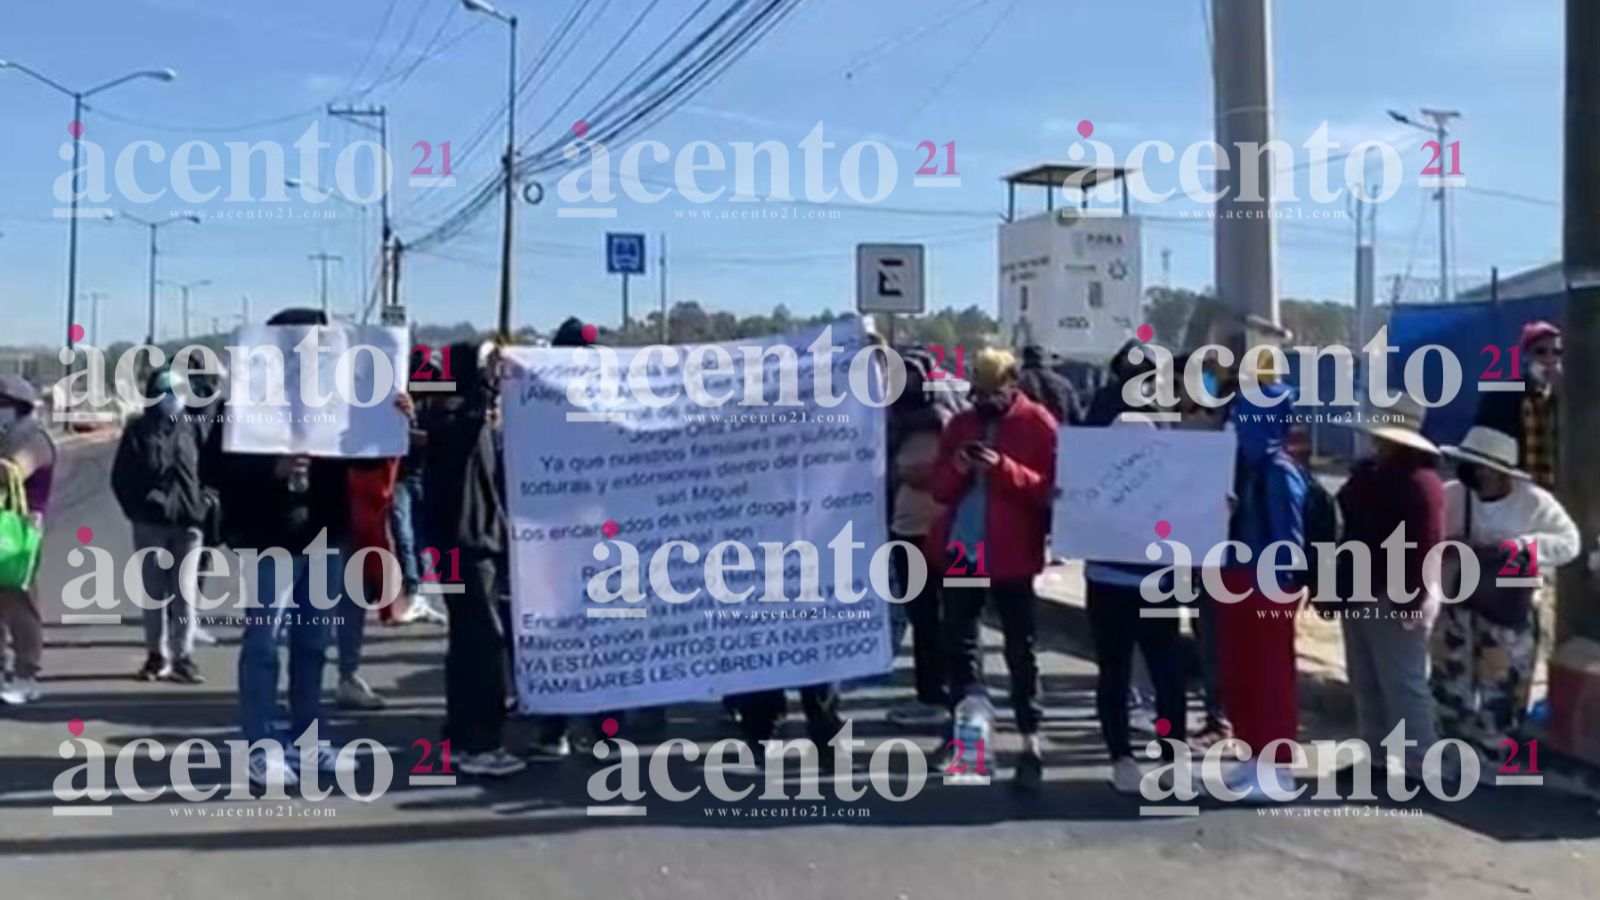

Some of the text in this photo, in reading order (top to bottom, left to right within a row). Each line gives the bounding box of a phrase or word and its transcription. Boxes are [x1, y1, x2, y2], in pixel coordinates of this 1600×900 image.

[520, 479, 592, 496] torturas
[596, 480, 608, 496] y
[716, 457, 770, 478] dentro
[773, 453, 799, 470] del
[540, 456, 565, 472] Ya
[569, 456, 605, 474] que
[608, 449, 686, 468] nuestros
[692, 480, 749, 503] Miguel
[511, 524, 544, 541] Los
[550, 516, 654, 540] encardos
[658, 515, 680, 533] de
[747, 500, 796, 518] droga
[519, 634, 585, 652] Marcos
[551, 648, 646, 674] ESTAMOS
[650, 636, 716, 661] ARTOS
[720, 631, 762, 651] QUE
[782, 616, 883, 645] NUESTROS
[527, 668, 645, 694] FAMILIARES
[650, 661, 687, 683] LES
[690, 652, 773, 677] COBREN
[777, 647, 819, 667] POR
